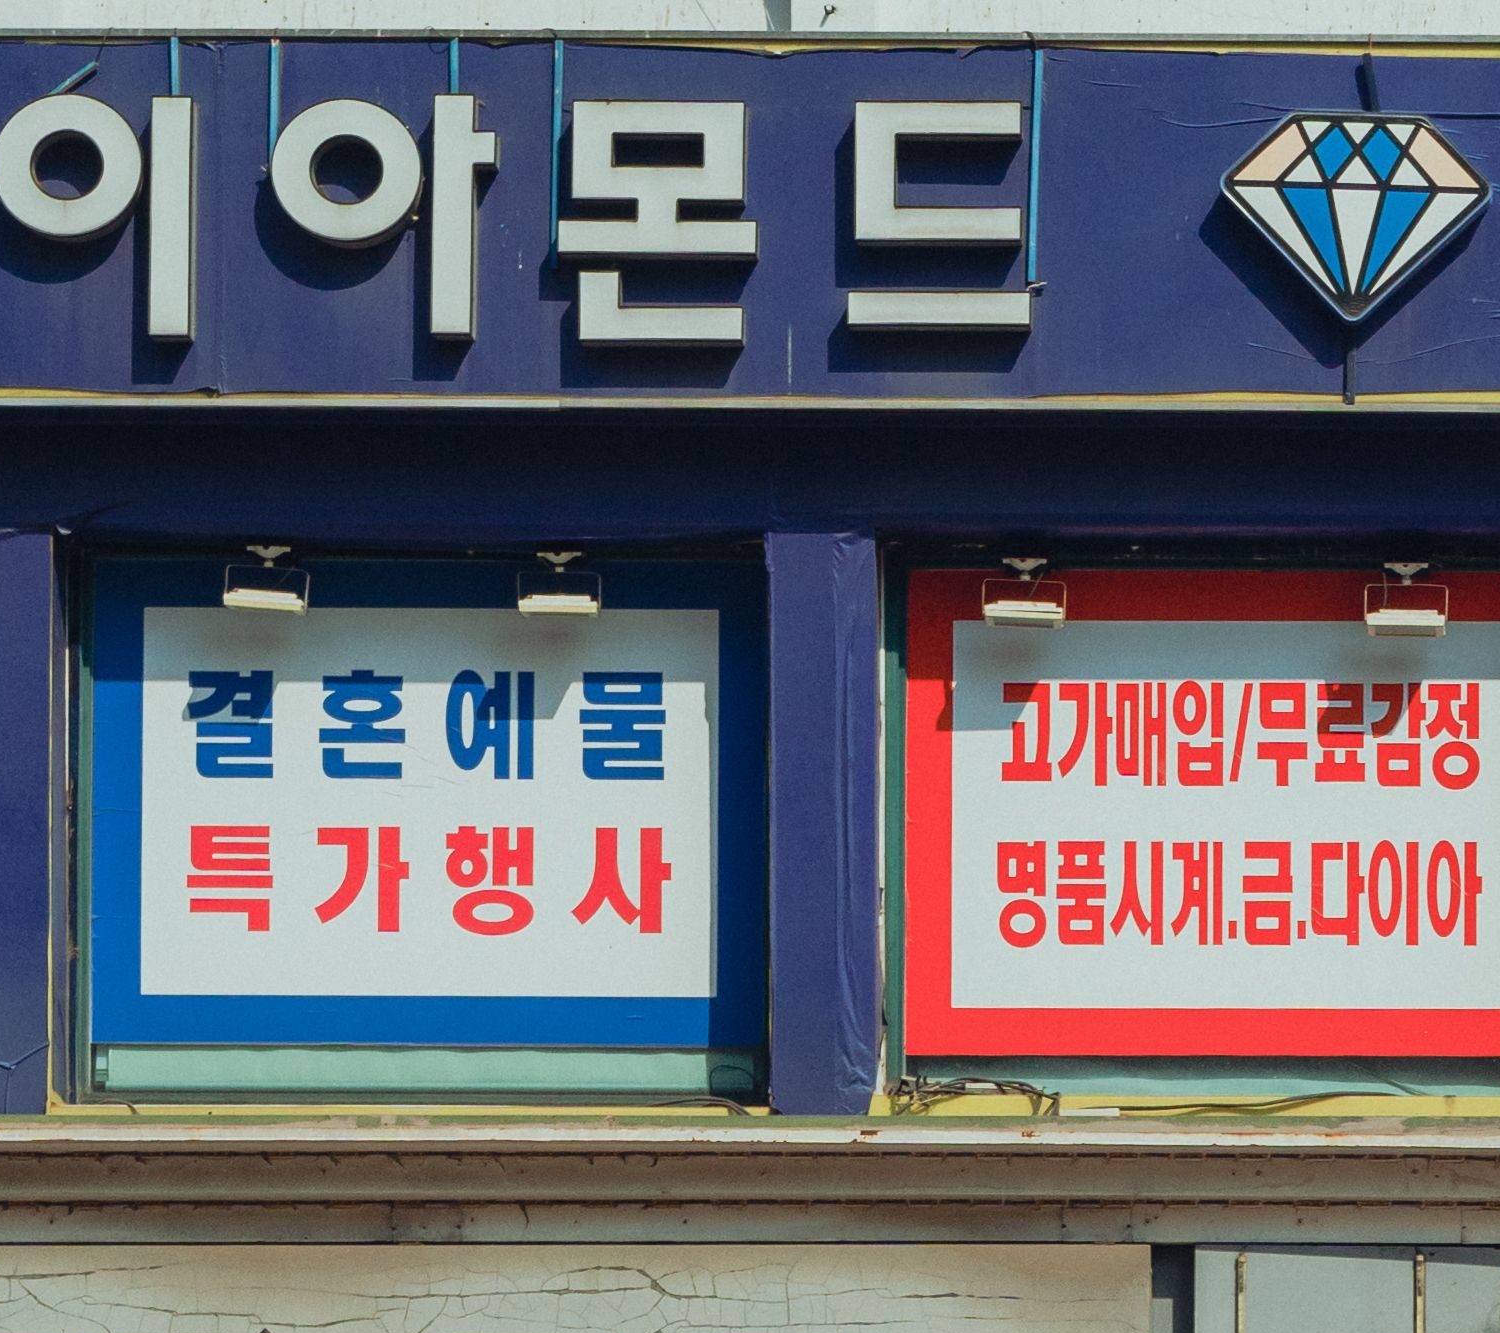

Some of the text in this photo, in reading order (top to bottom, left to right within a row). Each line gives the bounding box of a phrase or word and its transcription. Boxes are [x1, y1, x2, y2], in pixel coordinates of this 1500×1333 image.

[185, 668, 668, 781] 결혼예물
[1000, 678, 1484, 791] 고가매입/무료감정
[185, 824, 673, 936] 특가행사
[995, 839, 1485, 949] 명품시계.금.다이아
